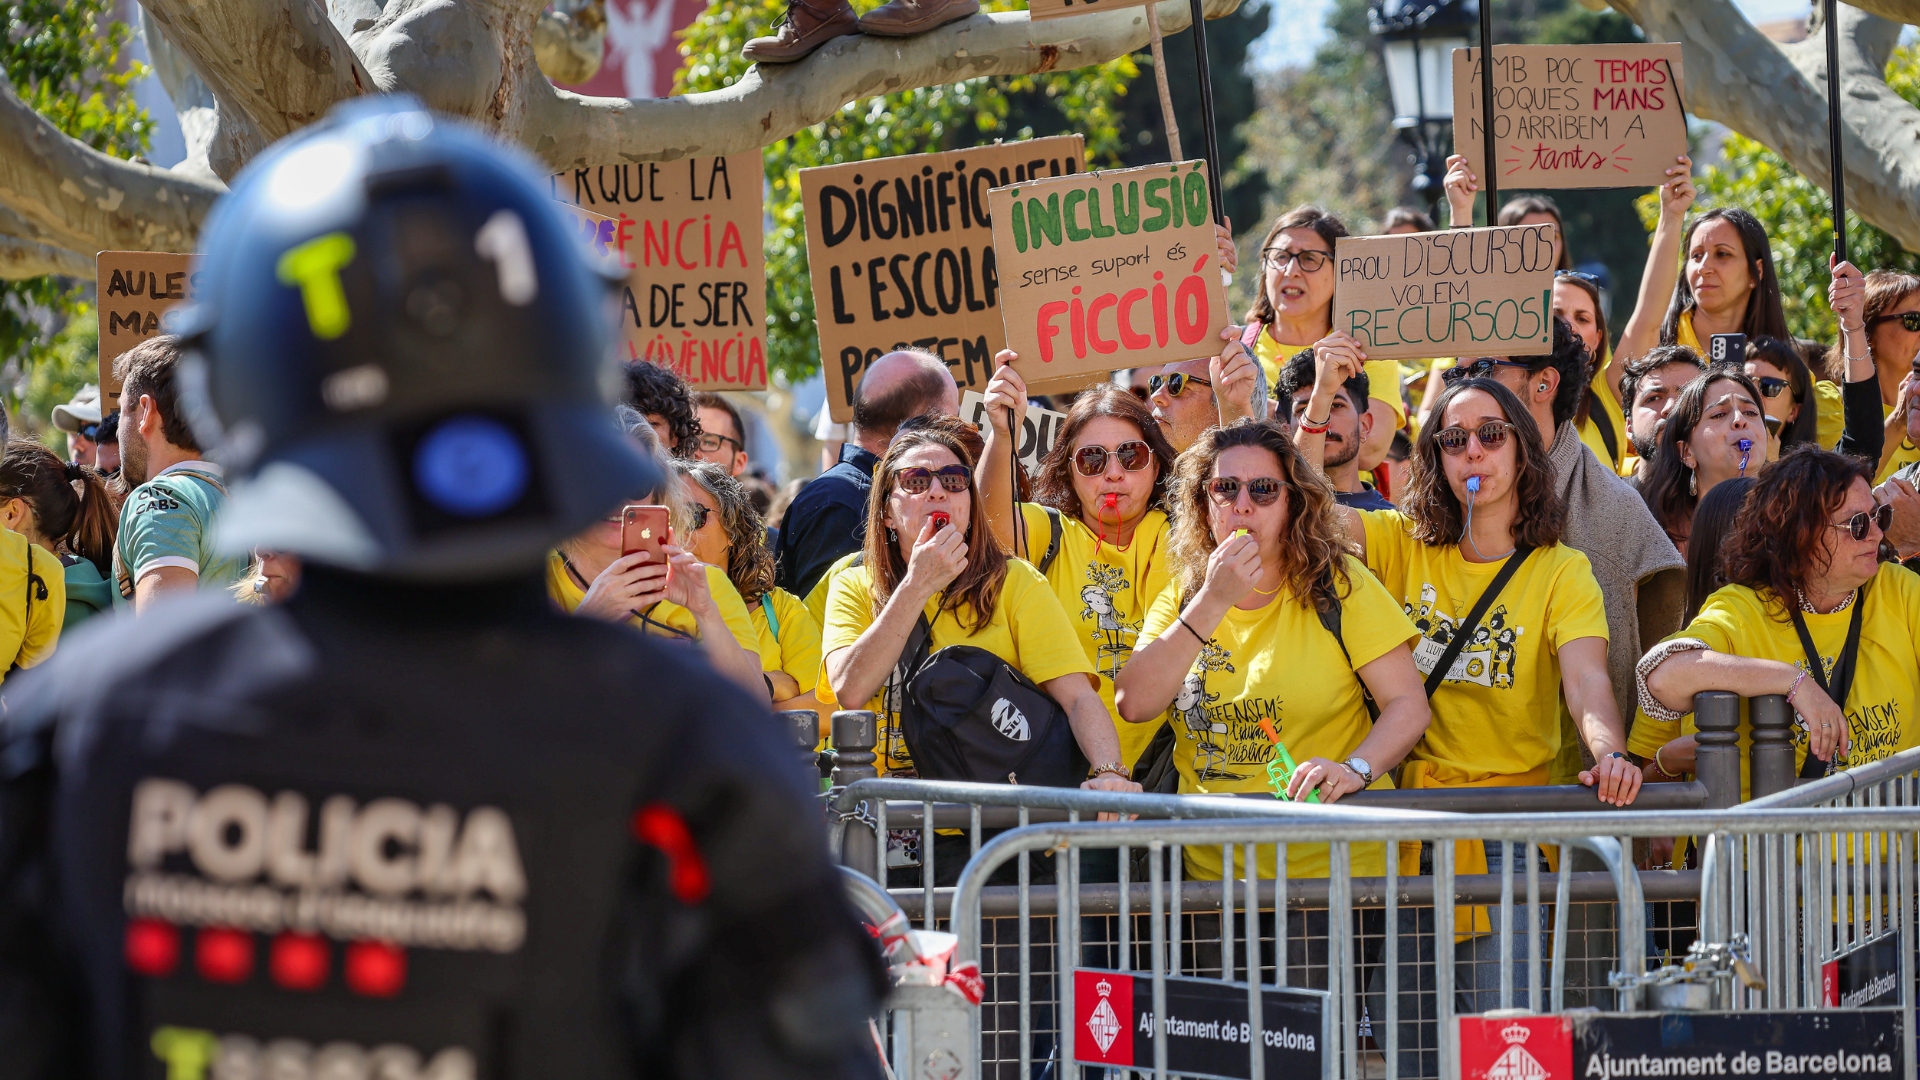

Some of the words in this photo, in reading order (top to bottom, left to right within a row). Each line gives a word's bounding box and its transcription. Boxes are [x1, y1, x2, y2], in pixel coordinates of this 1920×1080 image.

[1471, 55, 1528, 84] AMB
[1546, 57, 1583, 84] POC
[1594, 58, 1667, 85] TEMPS
[1492, 86, 1580, 114] OQUES
[1593, 86, 1666, 111] MANS
[1471, 114, 1512, 140] NO
[1517, 113, 1609, 140] ARRIBEM
[1624, 114, 1646, 140] A
[1528, 141, 1608, 171] tants
[690, 156, 732, 201] LA
[1010, 160, 1209, 254] INCLUSIÓ
[617, 212, 748, 271] ÈNCIA
[1340, 254, 1391, 282] PROU
[1403, 224, 1554, 279] DISCURSOS
[830, 245, 999, 325] L'ESCOLA
[1019, 263, 1081, 288] sense
[1091, 244, 1150, 278] suport
[1166, 242, 1187, 261] és
[620, 285, 642, 328] A
[650, 282, 686, 328] DE
[693, 281, 754, 327] SER
[1036, 253, 1209, 363] FICCIÓ
[1391, 280, 1470, 307] VOLEM
[1346, 289, 1551, 348] RECURSOS!
[616, 329, 767, 386] VIVÈNCIA
[135, 498, 179, 515] CABS
[137, 484, 174, 501] CITY
[1206, 698, 1277, 724] DEFENSEM
[1847, 701, 1897, 736] ENSEM
[127, 777, 527, 899] POLICIA
[1874, 970, 1896, 998] Barcelona
[1138, 1011, 1220, 1040] Ajntament
[1221, 1020, 1238, 1043] de
[1239, 1022, 1316, 1052] Brcelona
[1585, 1051, 1727, 1080] Ajuntament
[1730, 1049, 1762, 1075] de
[1766, 1048, 1893, 1075] Barcelona
